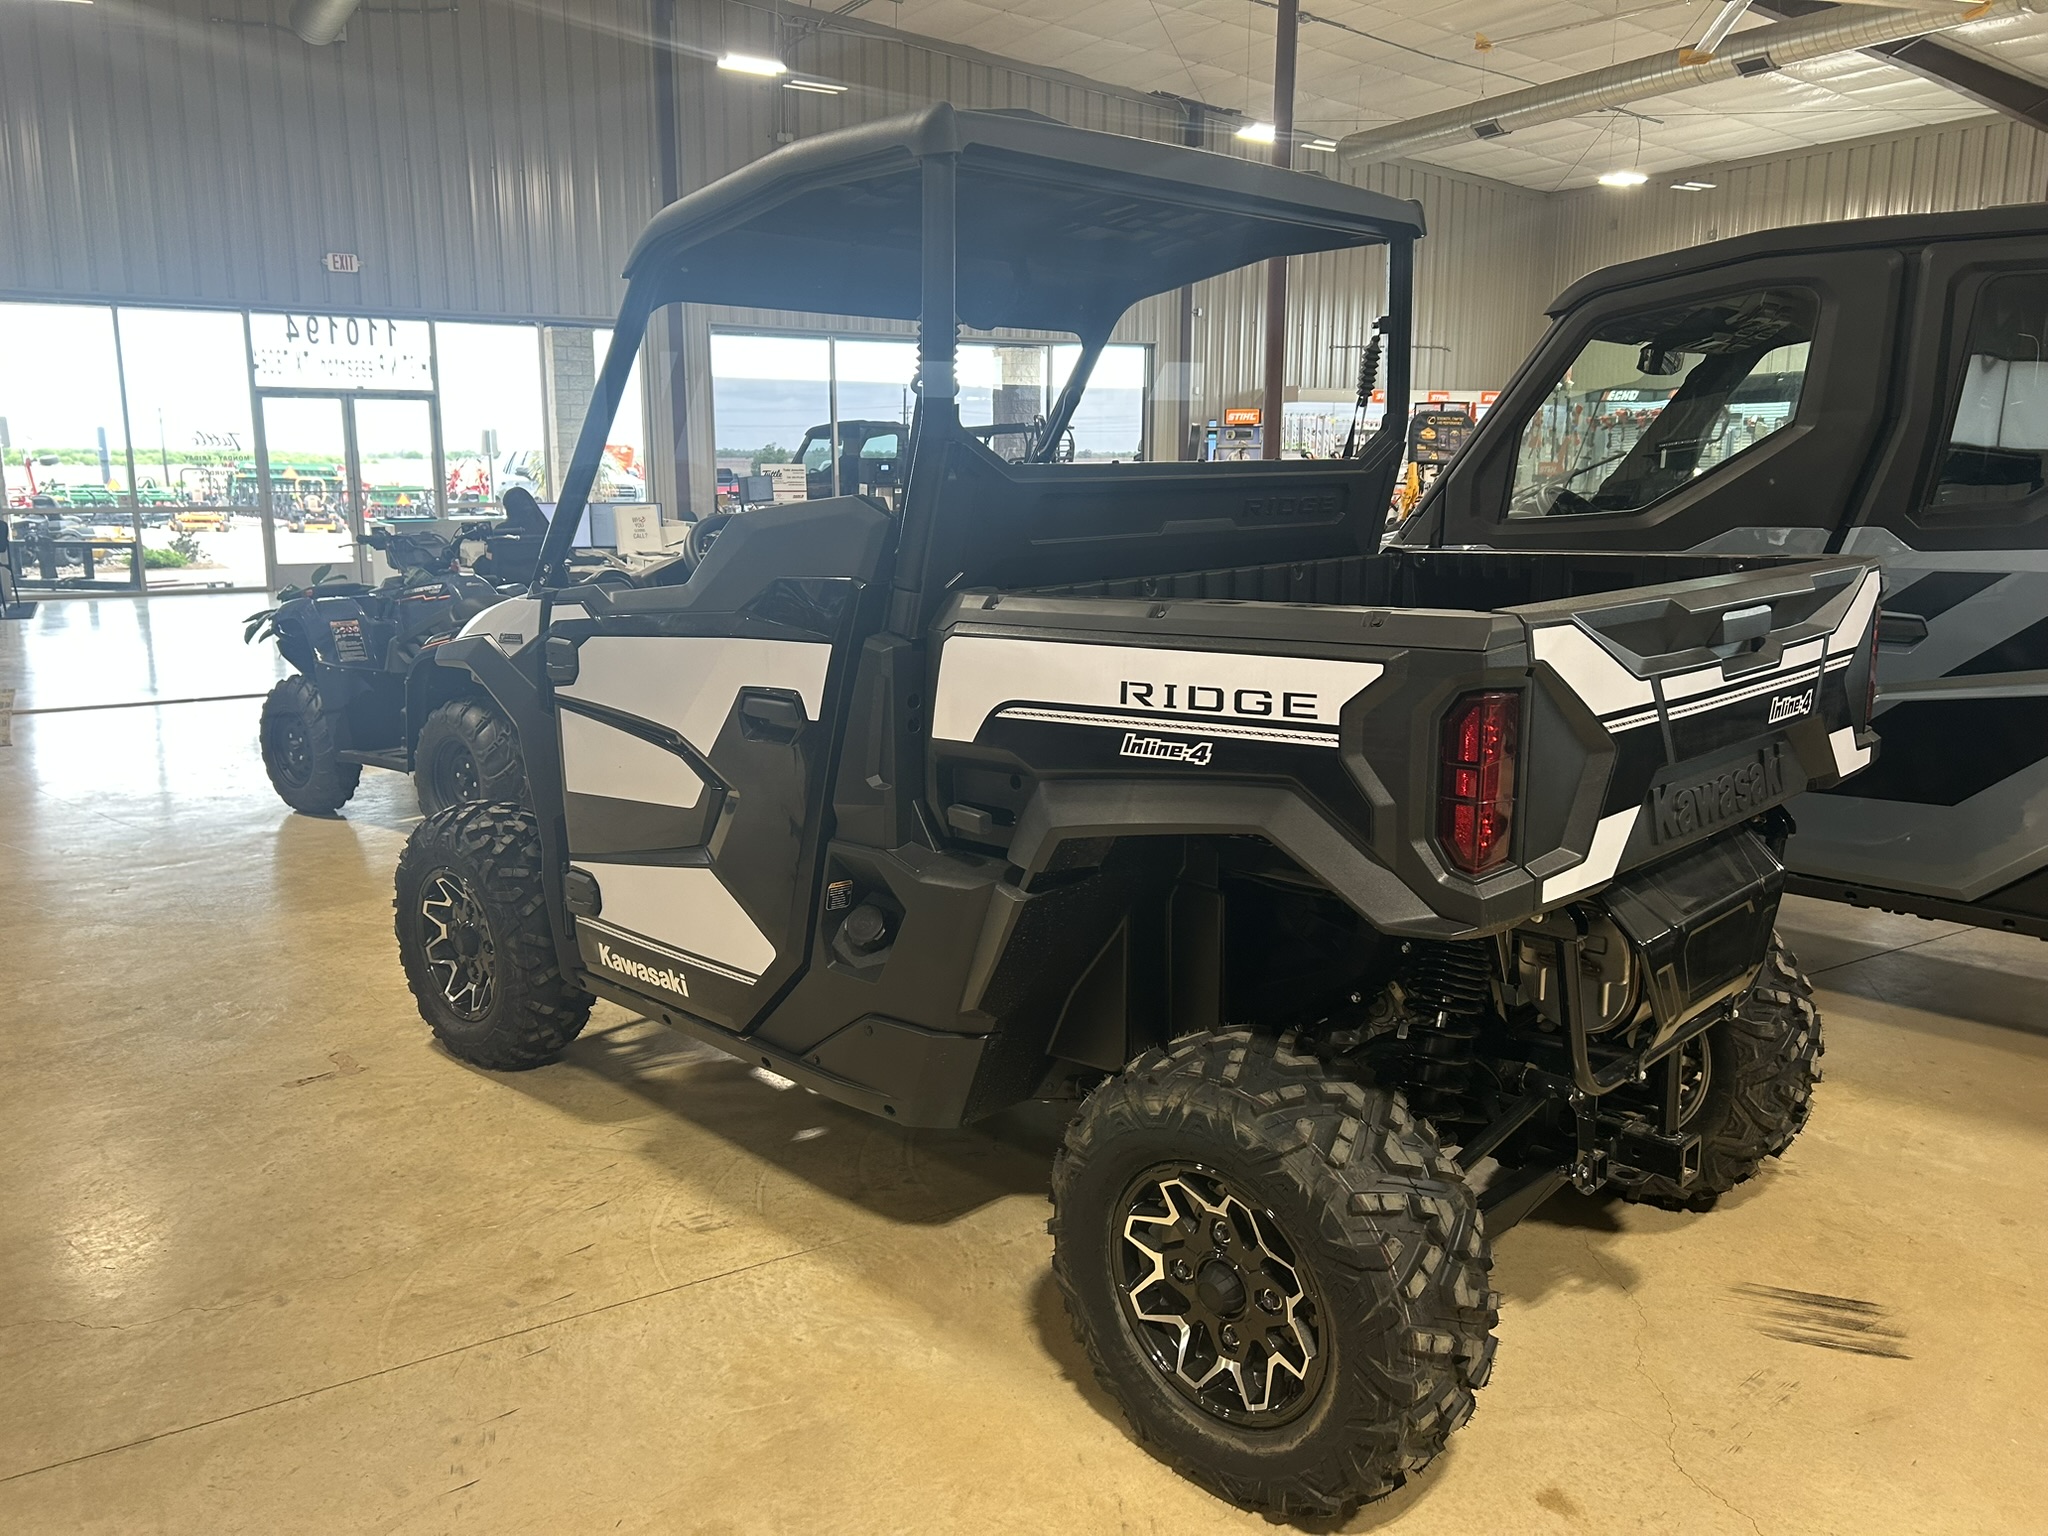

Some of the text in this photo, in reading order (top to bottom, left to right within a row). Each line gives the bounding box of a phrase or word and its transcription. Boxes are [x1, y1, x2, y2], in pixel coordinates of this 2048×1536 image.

[332, 254, 354, 271] EXIT
[1607, 390, 1640, 401] ECHO
[1227, 412, 1257, 421] STIHL
[1242, 494, 1337, 518] RIDGE
[1120, 681, 1318, 719] RIDGE
[1768, 689, 1814, 724] Inline-4
[1120, 733, 1213, 765] Inline-4
[1651, 741, 1785, 845] Kawasaki
[598, 942, 690, 998] Kawasaki
